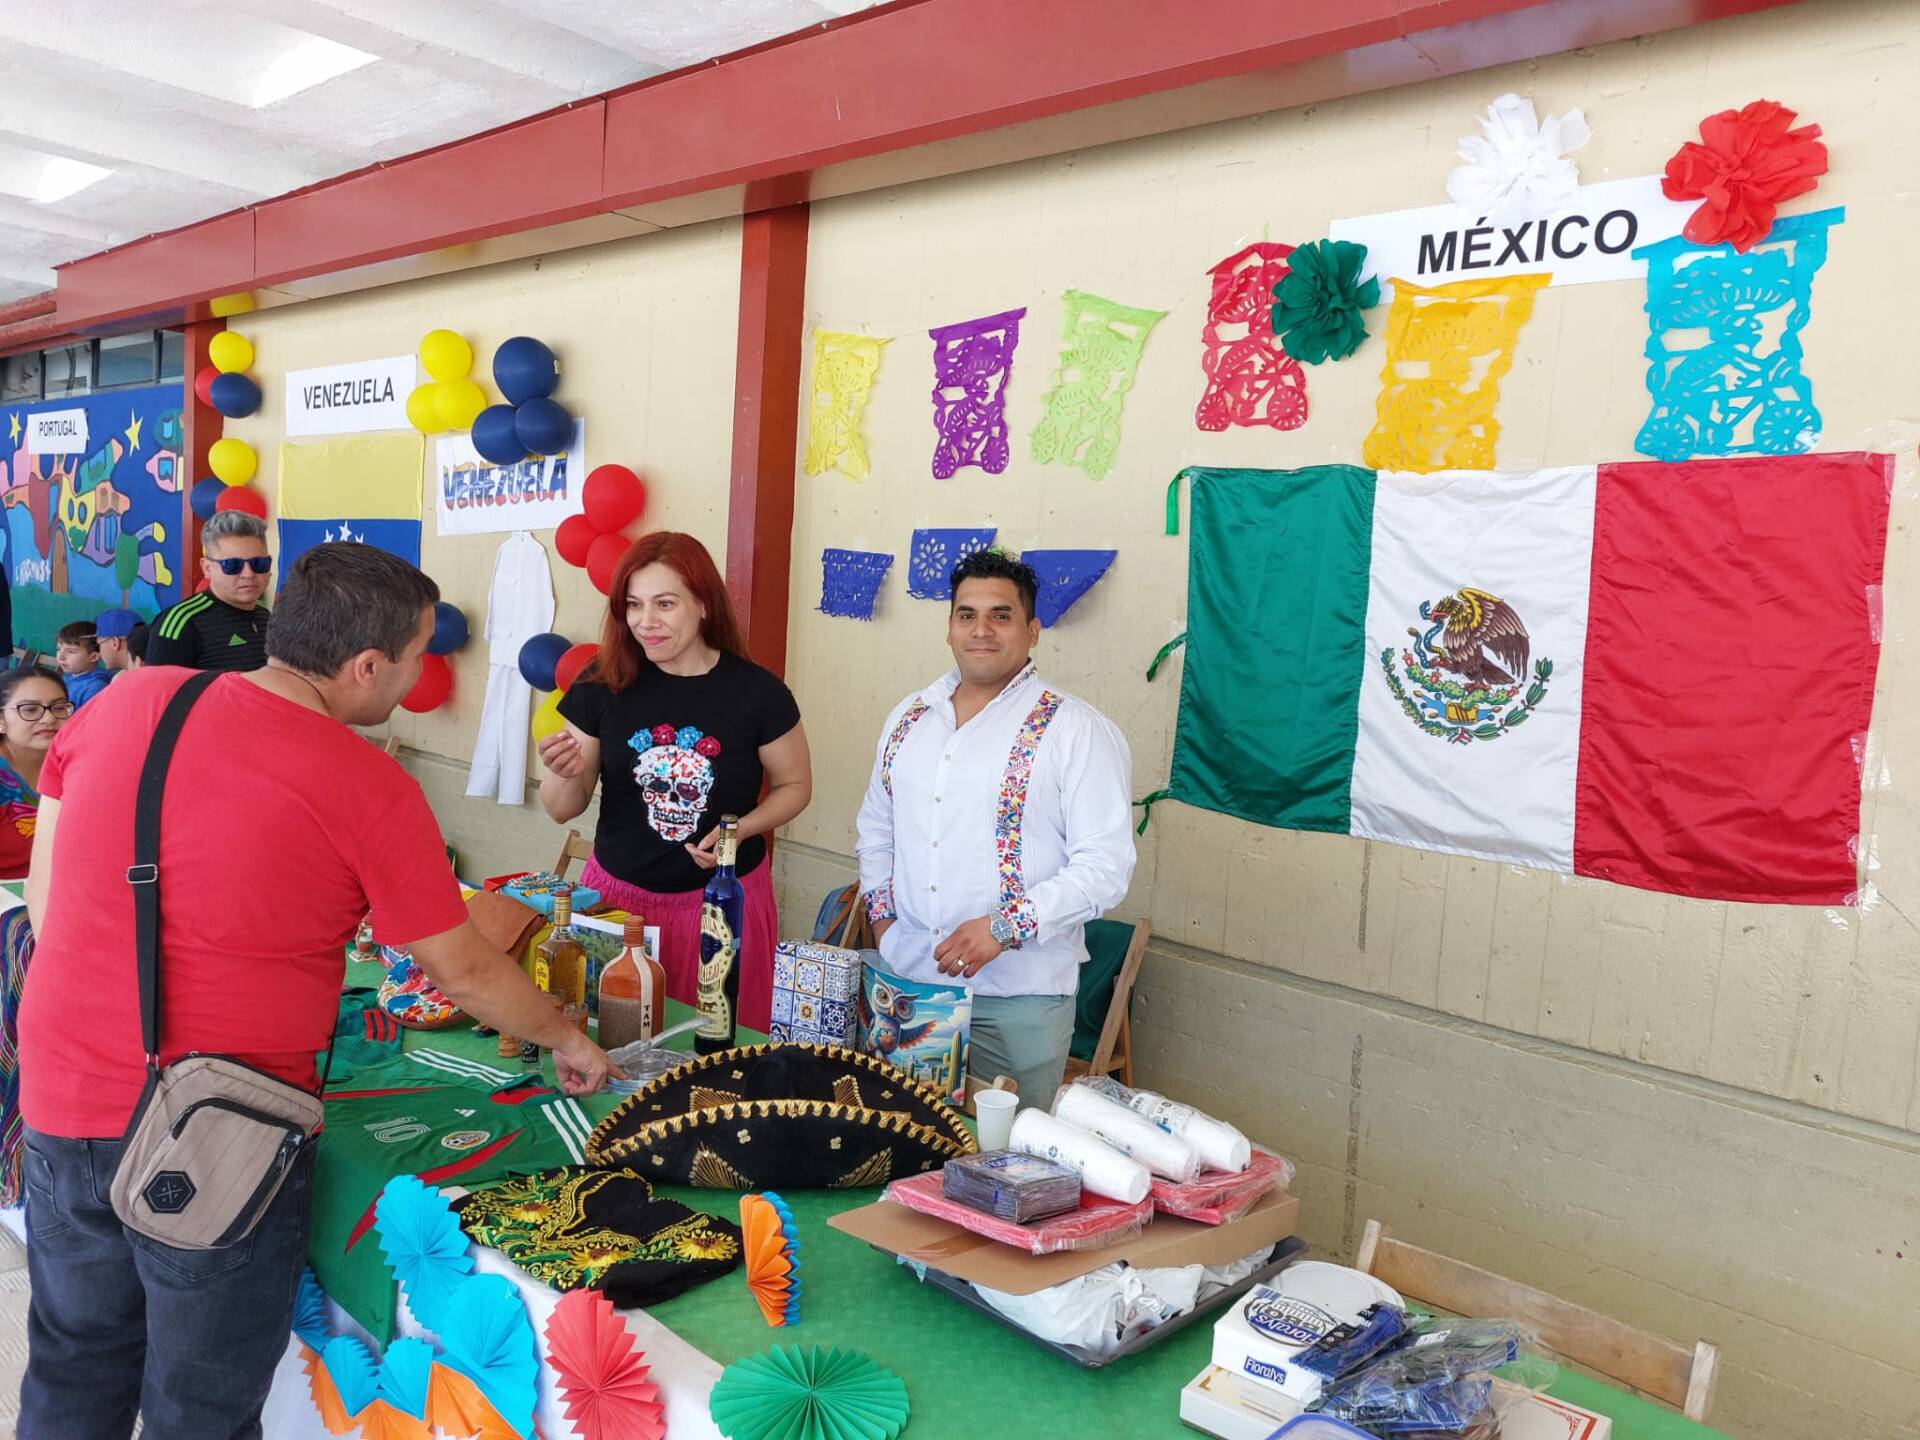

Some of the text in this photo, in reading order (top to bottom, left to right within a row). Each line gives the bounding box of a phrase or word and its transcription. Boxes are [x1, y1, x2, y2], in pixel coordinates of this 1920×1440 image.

[1417, 209, 1638, 275] MÉXICO
[303, 376, 395, 410] VENEZUELA
[39, 419, 78, 437] PORTUGAL
[443, 450, 568, 511] VENEZUELA
[1255, 1313, 1321, 1345] Floralys
[1245, 1358, 1286, 1385] Floralys
